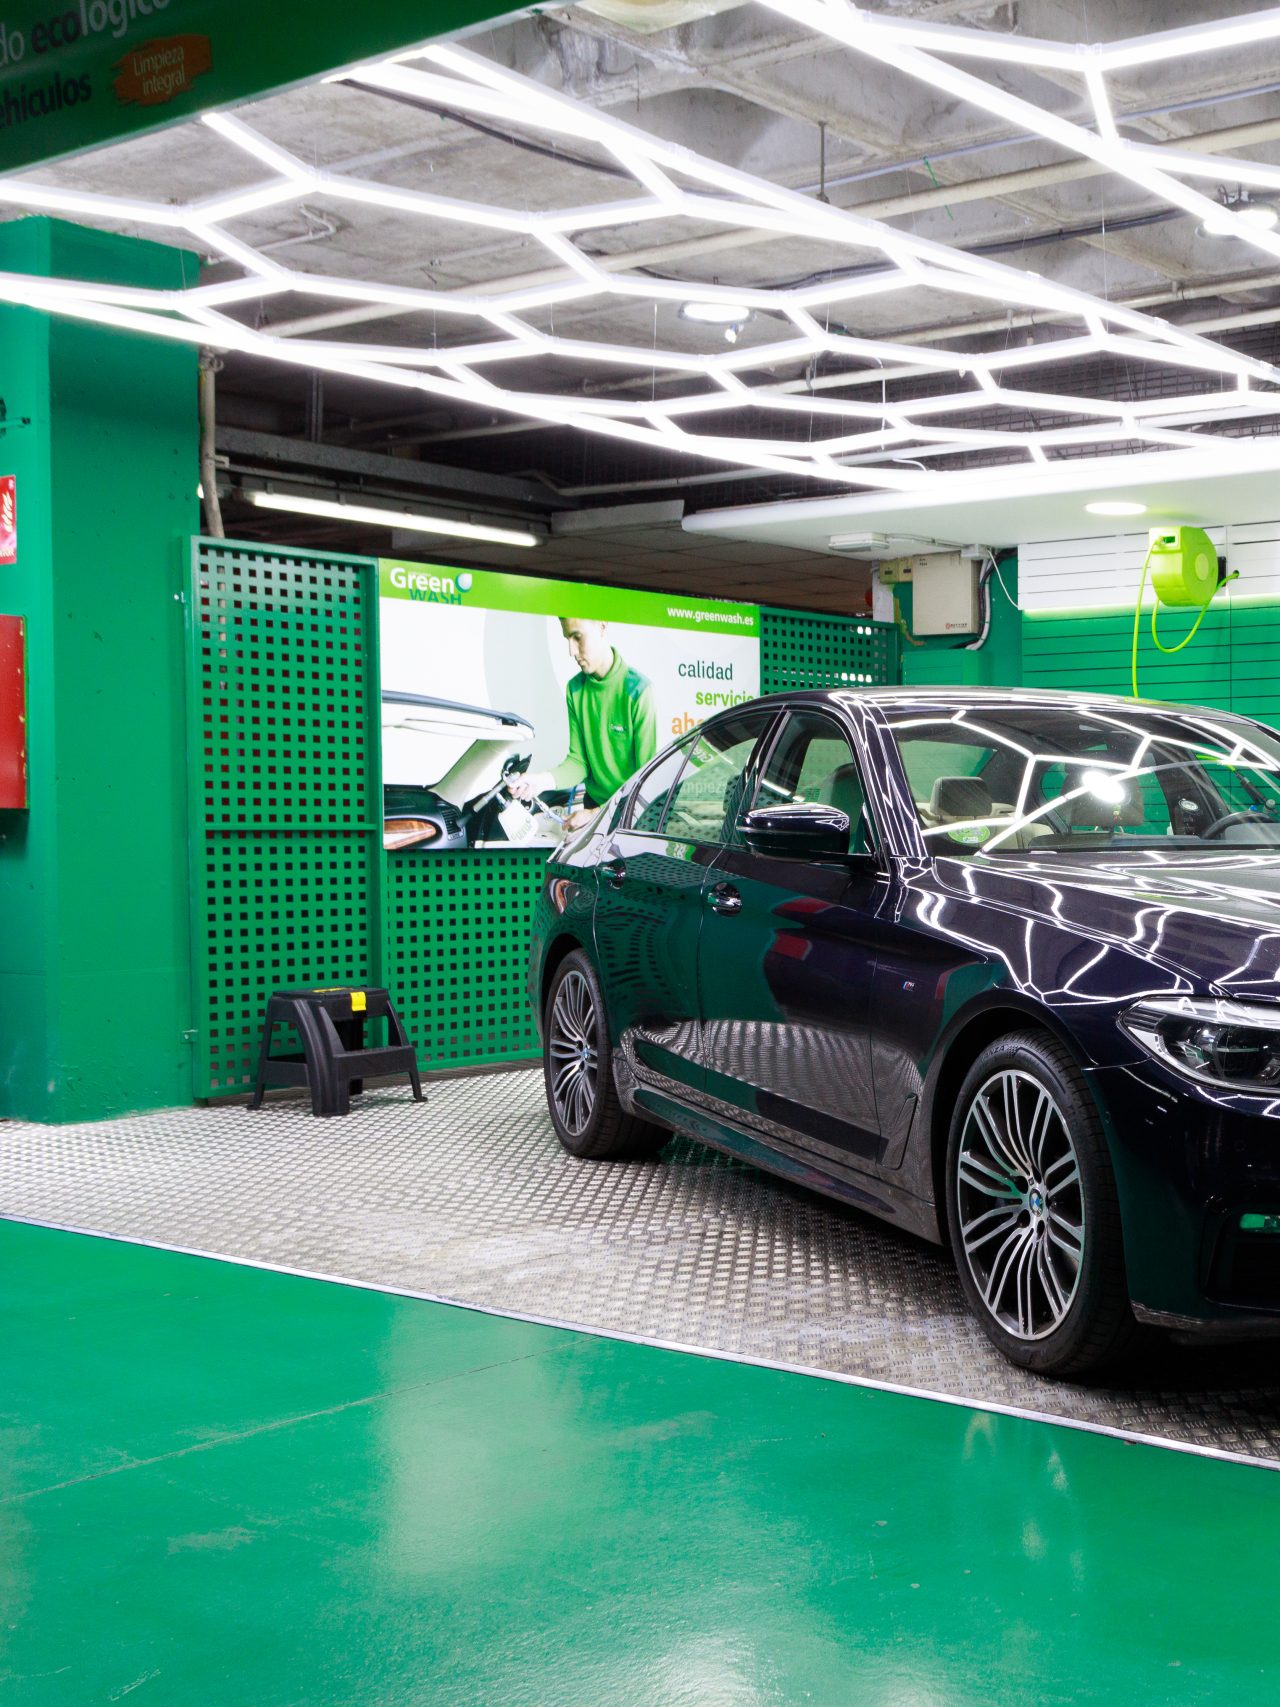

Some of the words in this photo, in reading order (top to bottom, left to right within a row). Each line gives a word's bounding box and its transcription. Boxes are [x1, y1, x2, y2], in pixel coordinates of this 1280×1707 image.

[133, 46, 185, 77] Limpieza
[142, 66, 186, 97] integral
[390, 567, 455, 594] Green
[409, 588, 462, 606] WASH
[667, 606, 754, 626] www.greenwash.es
[678, 660, 733, 681] calidad
[671, 711, 703, 735] ah
